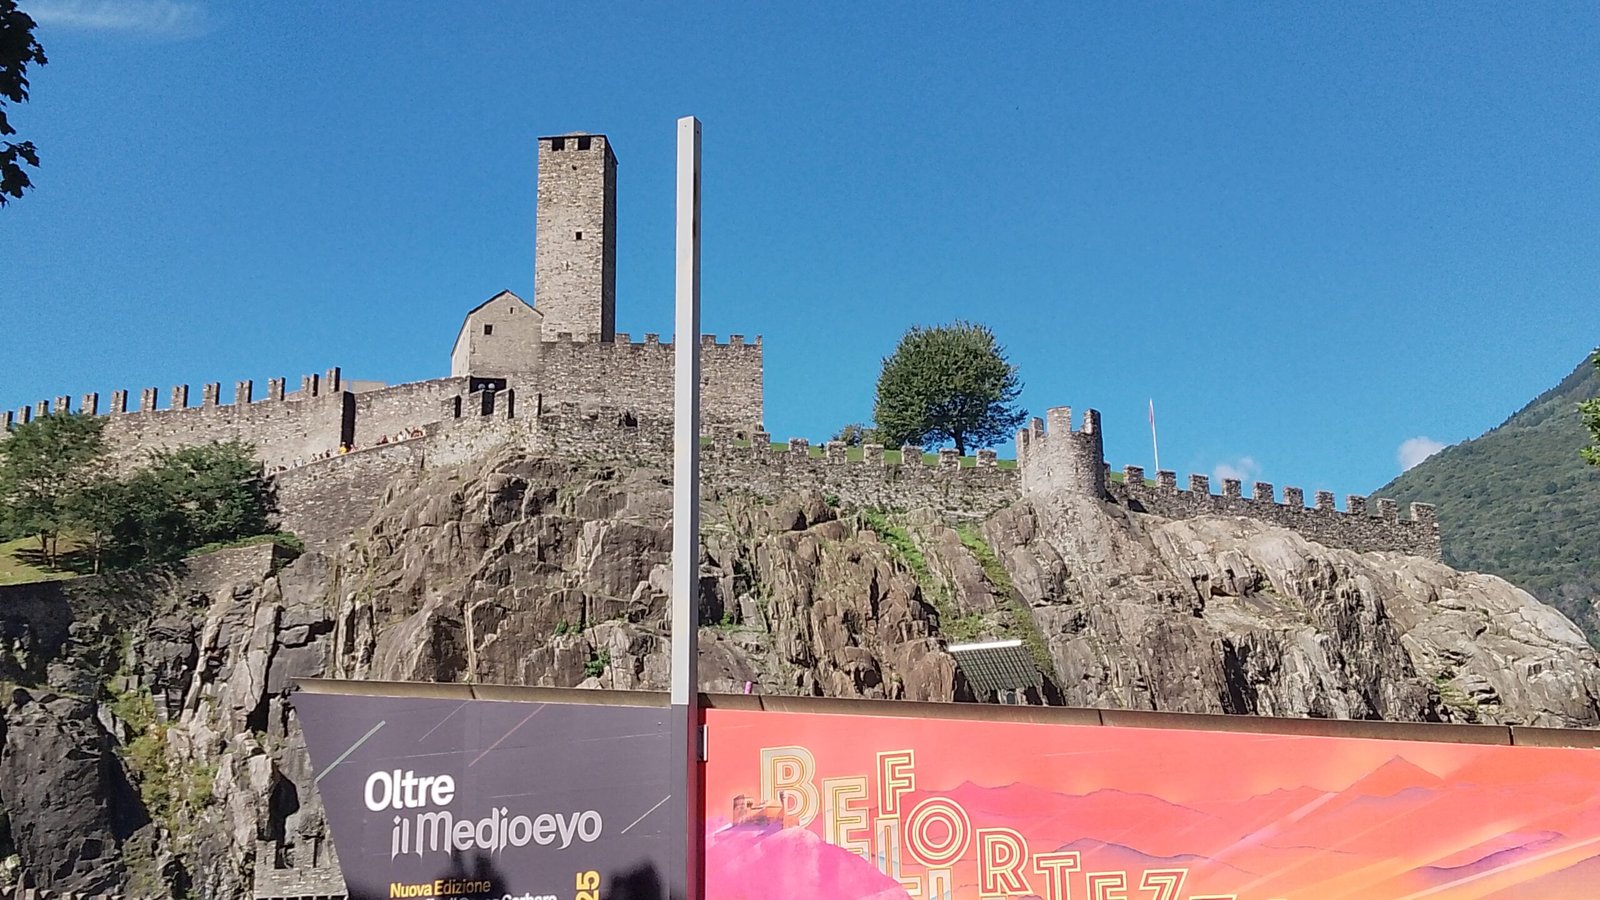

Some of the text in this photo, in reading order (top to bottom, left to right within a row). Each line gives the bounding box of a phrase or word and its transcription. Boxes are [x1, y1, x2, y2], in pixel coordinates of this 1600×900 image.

[364, 769, 456, 812] Oltre
[391, 815, 410, 862] il
[389, 878, 492, 899] Nuova Edizione
